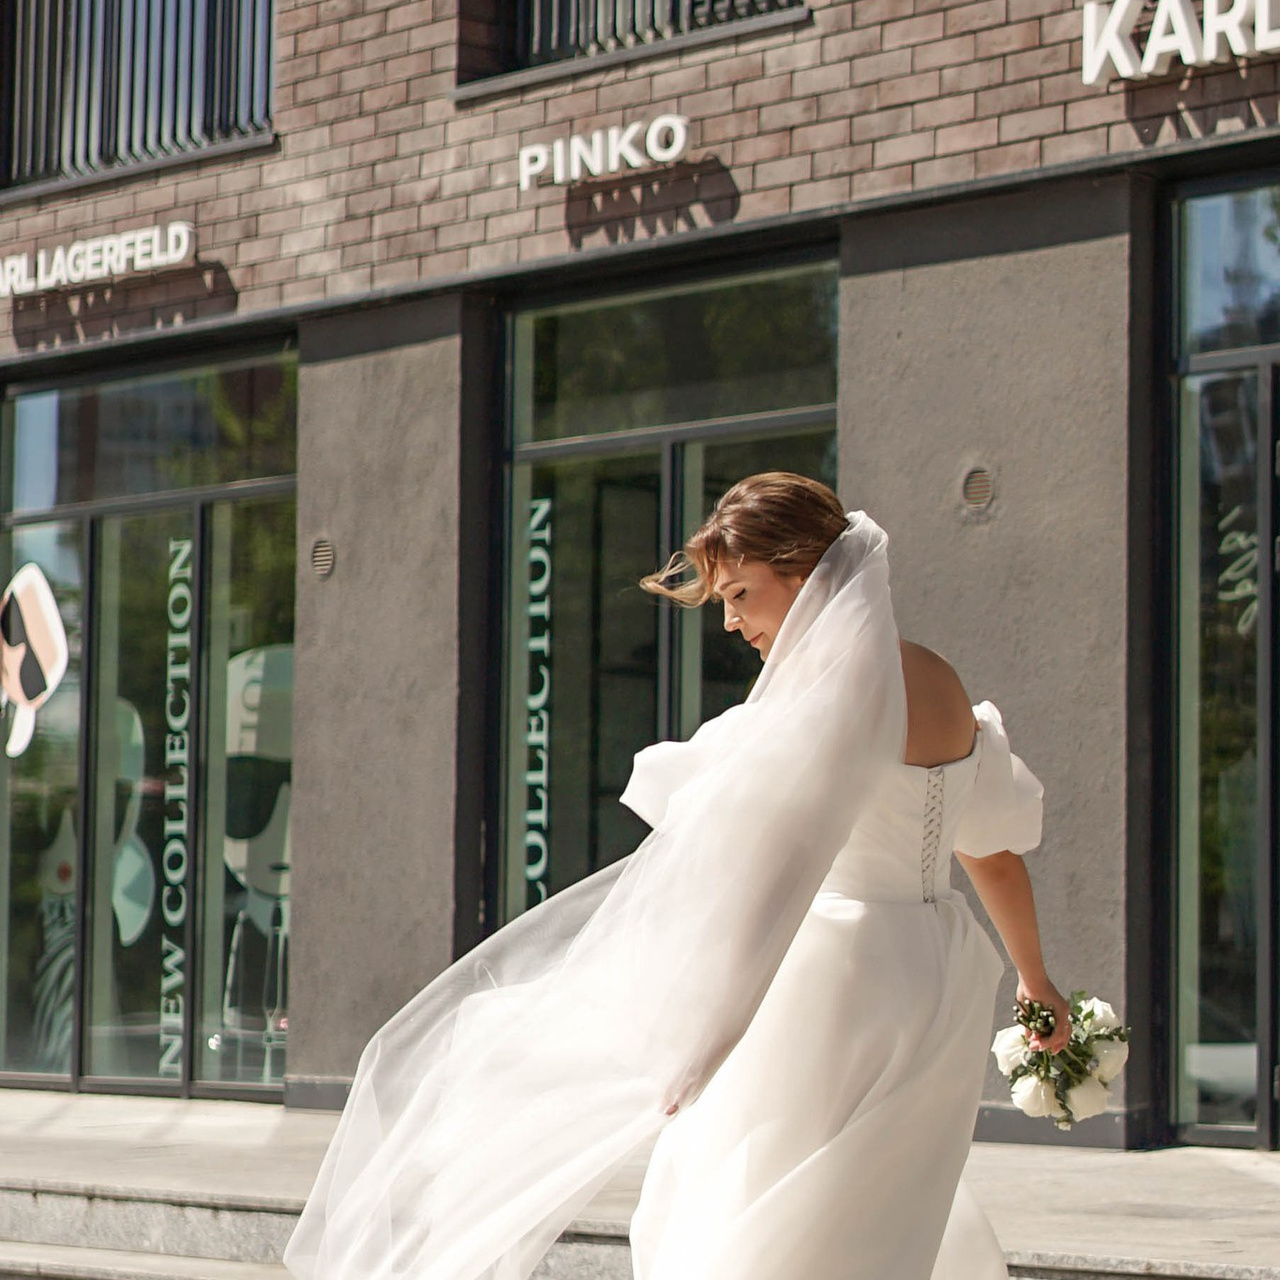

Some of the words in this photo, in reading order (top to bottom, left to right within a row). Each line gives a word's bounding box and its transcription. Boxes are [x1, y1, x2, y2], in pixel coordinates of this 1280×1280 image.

[518, 114, 689, 192] PINKO
[36, 221, 195, 290] LAGERFELD
[161, 539, 193, 927] COLLECTION
[524, 498, 552, 902] OLLECTION
[159, 933, 185, 1078] NEW
